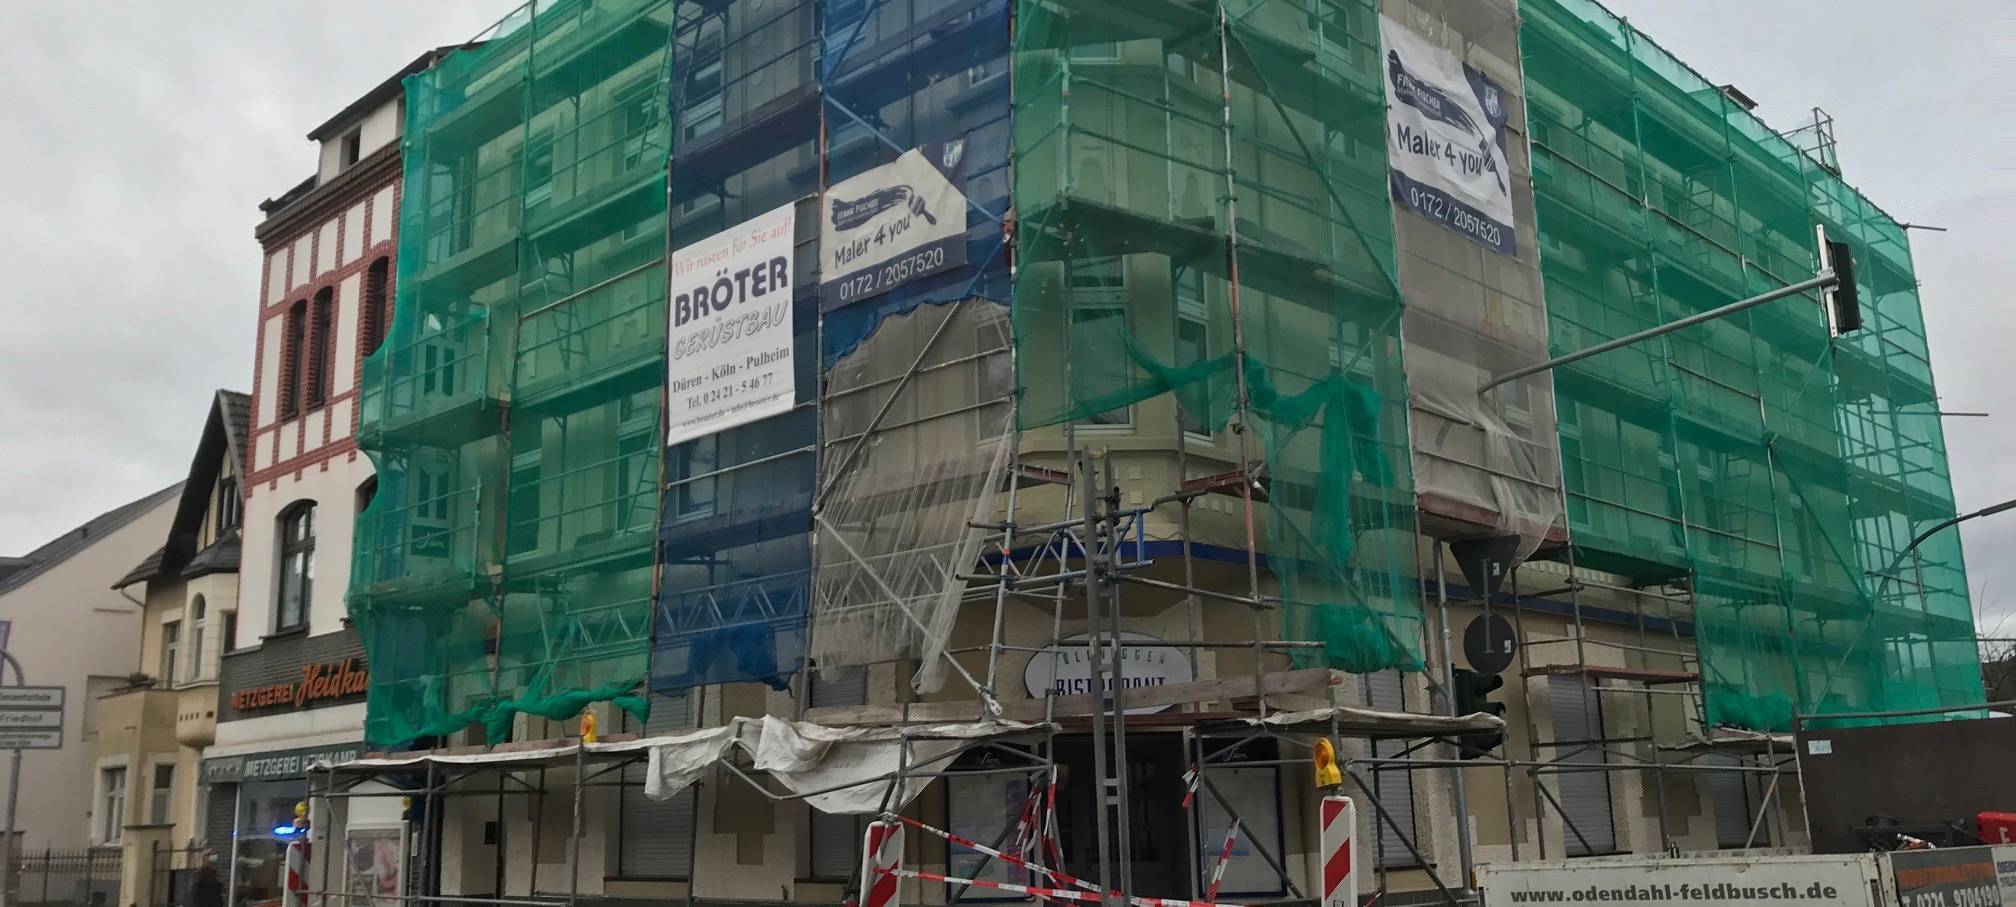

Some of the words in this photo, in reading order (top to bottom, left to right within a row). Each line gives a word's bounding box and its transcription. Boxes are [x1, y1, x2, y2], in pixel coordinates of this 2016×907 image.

[1397, 122, 1441, 160] Maler
[1445, 142, 1456, 167] 4
[1459, 151, 1484, 176] you
[834, 237, 871, 270] Maler
[874, 224, 886, 246] 4
[889, 213, 911, 242] you
[1410, 187, 1443, 218] 0172
[1454, 207, 1501, 246] 2057520
[674, 255, 788, 328] BRÖTER
[840, 273, 873, 300] 0172
[885, 247, 944, 286] 2057520
[674, 299, 788, 361] GERÜSTBAU
[673, 374, 702, 394] Düren
[712, 363, 736, 381] Köln
[746, 347, 790, 370] Pulheim
[687, 395, 702, 410] Tel.
[711, 389, 721, 402] 24
[723, 384, 733, 398] 21
[741, 380, 747, 393] 5
[749, 376, 760, 390] 46
[762, 372, 773, 385] 77
[244, 756, 301, 777] METZGEREI
[1511, 881, 1838, 903] www.odendahl-feldbusch.de
